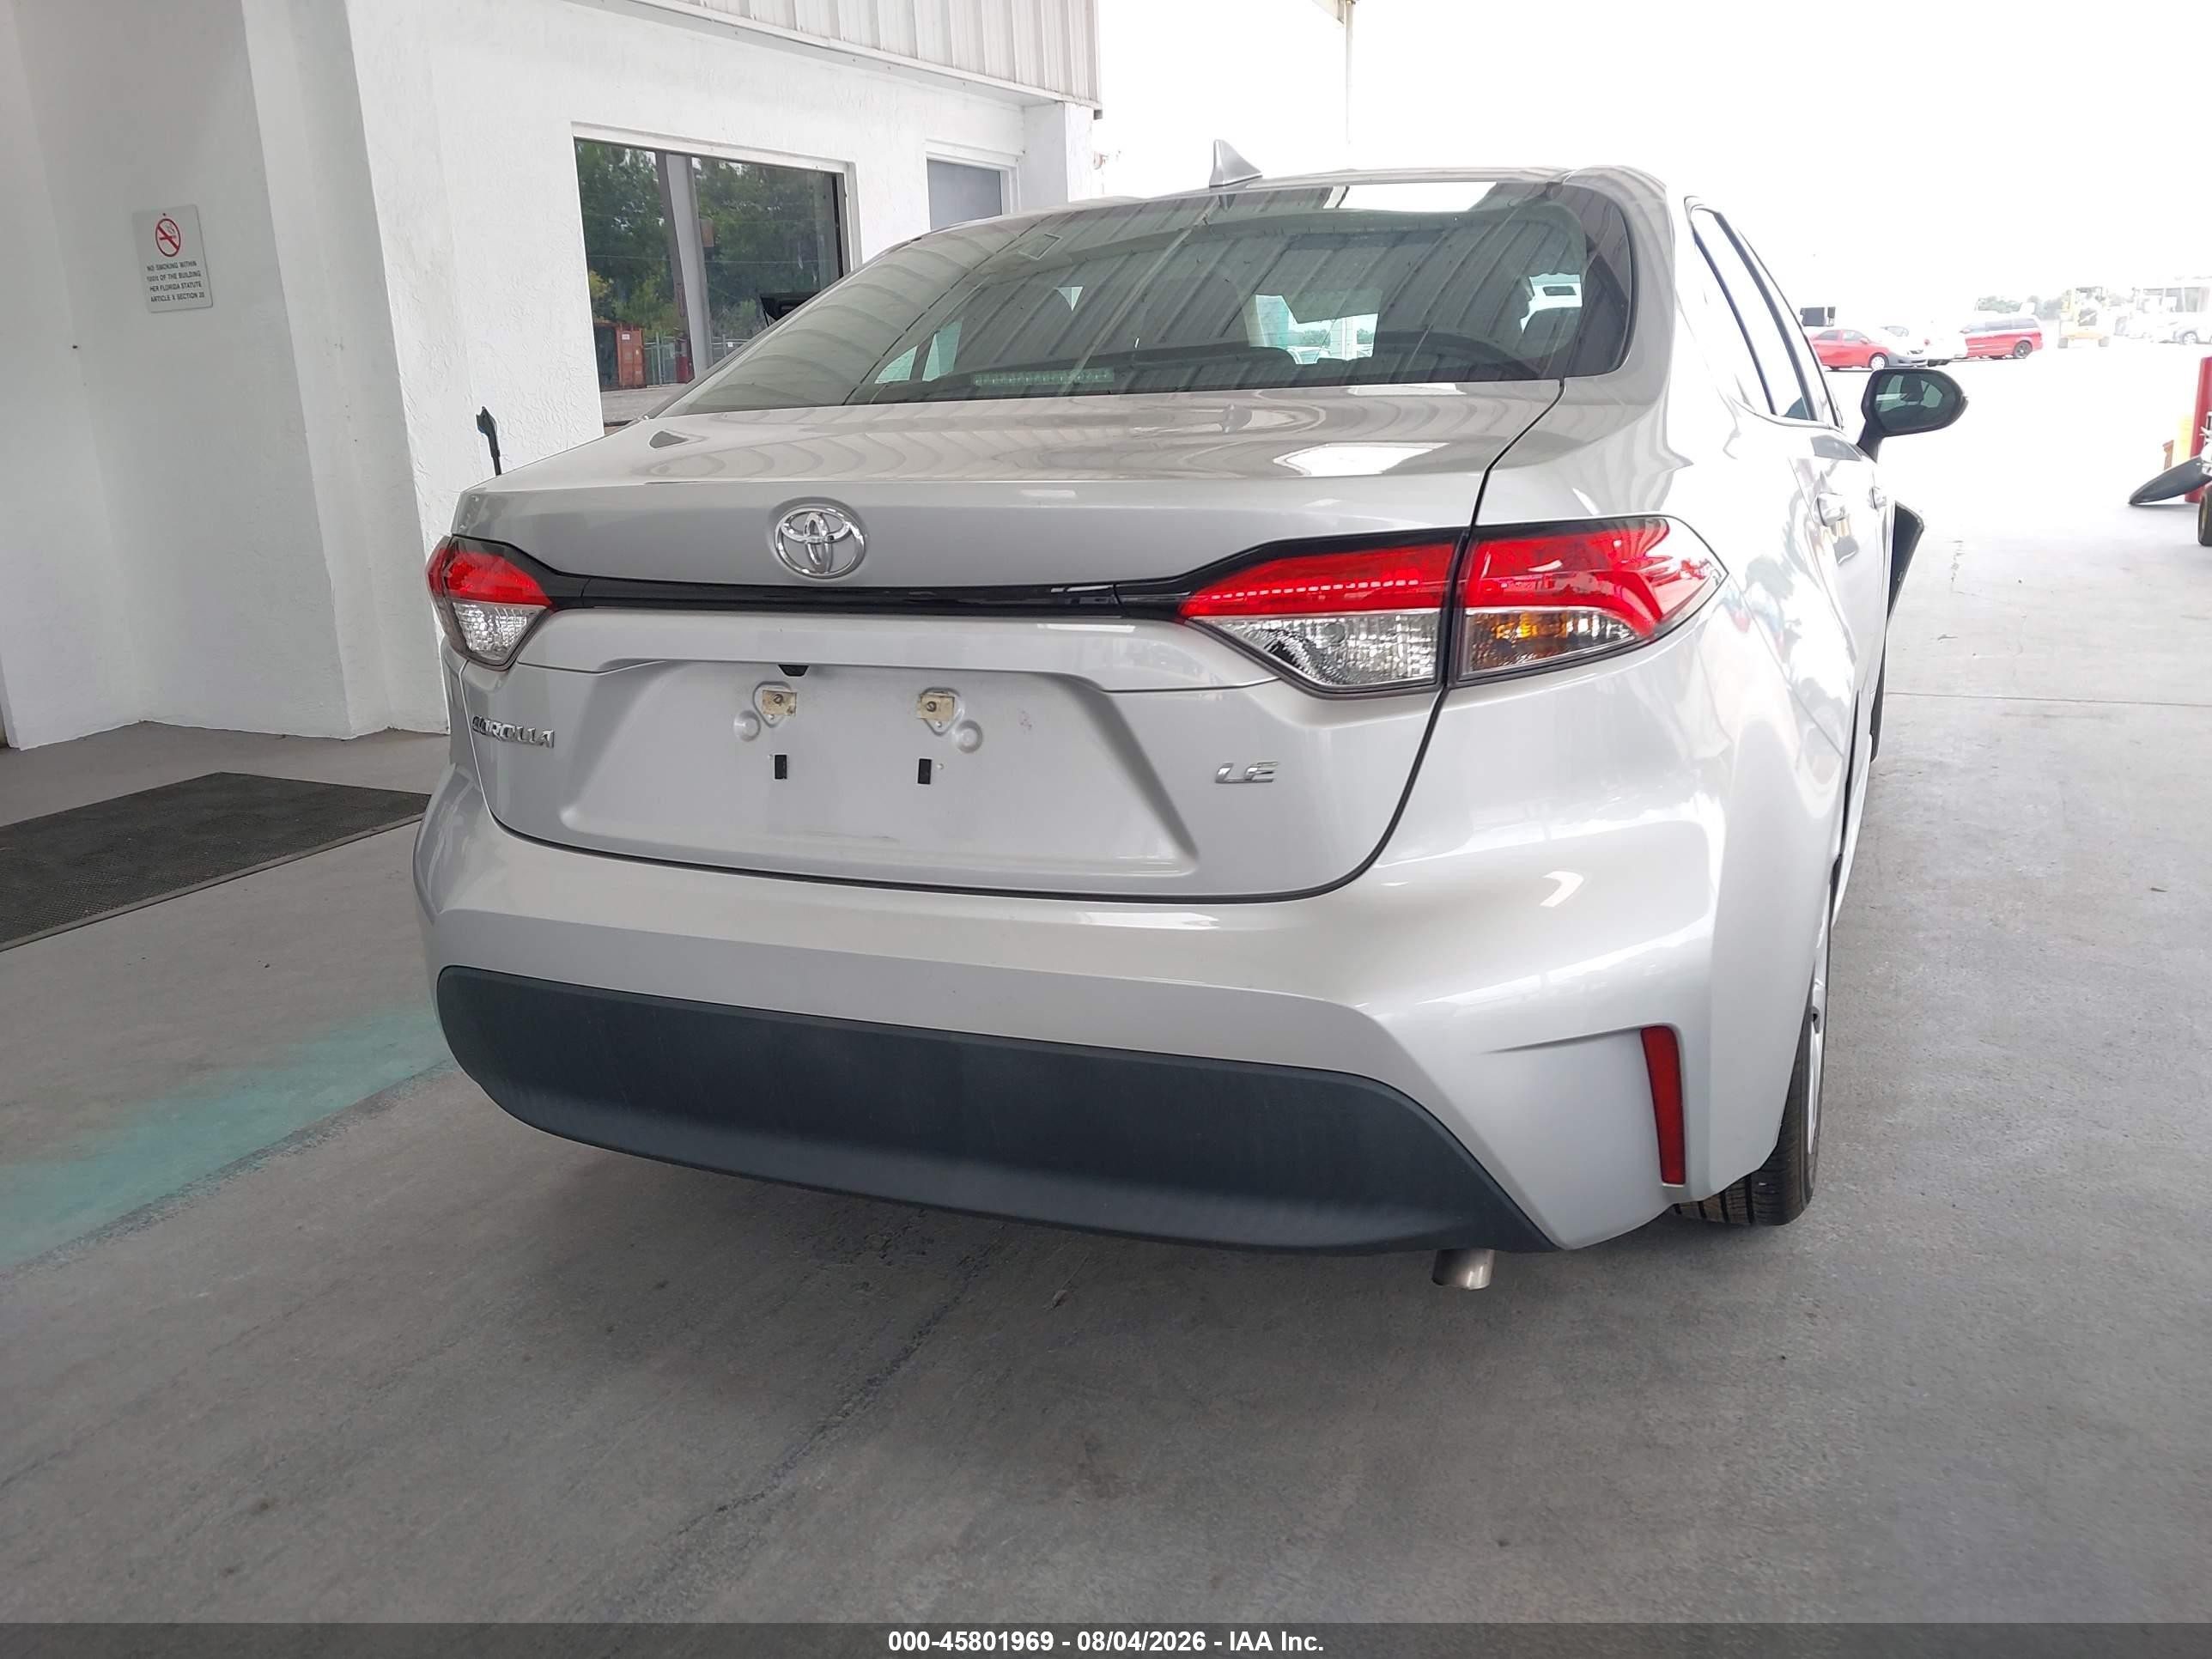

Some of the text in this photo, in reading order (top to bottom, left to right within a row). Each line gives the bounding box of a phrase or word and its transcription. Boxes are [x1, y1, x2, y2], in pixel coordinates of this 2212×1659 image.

[156, 262, 179, 270] SMOKING
[179, 270, 201, 279] BUILDING
[181, 281, 202, 289] STATUTE
[1214, 761, 1278, 784] LE
